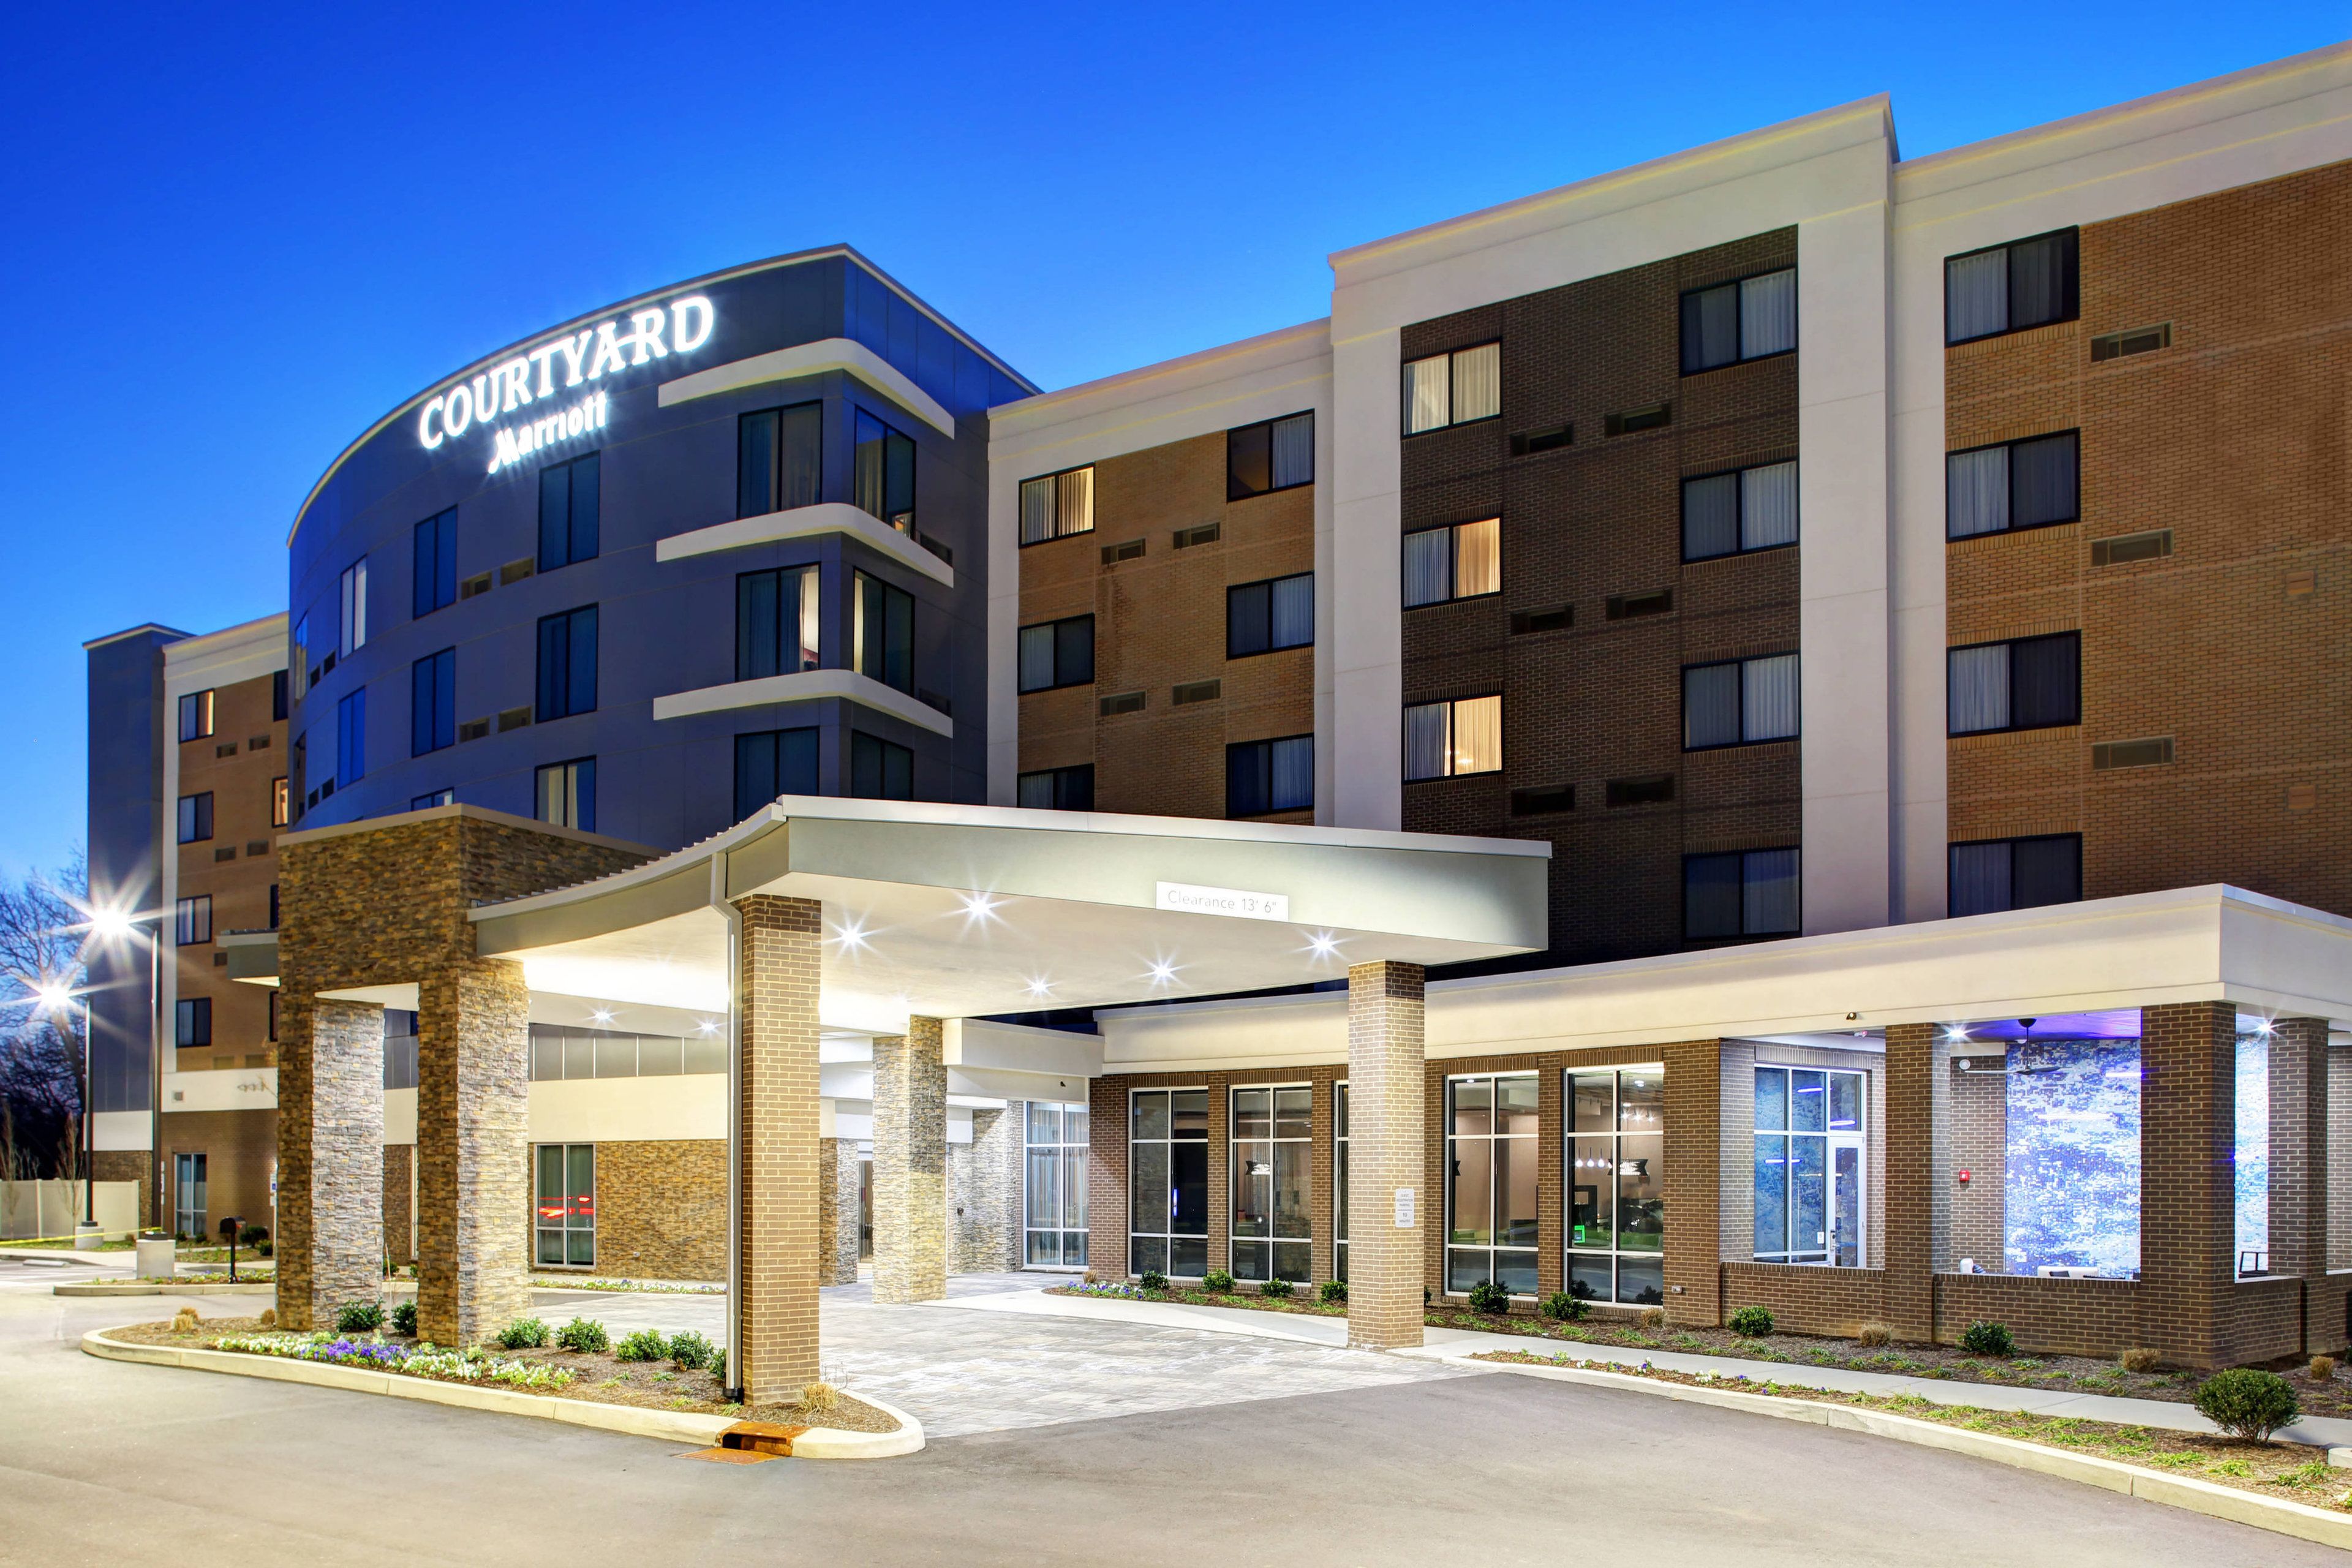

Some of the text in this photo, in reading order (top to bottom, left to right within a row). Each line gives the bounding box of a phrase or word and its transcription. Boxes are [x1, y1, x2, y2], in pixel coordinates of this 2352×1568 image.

[420, 296, 713, 449] COURTYARD
[488, 391, 608, 473] Marriott
[1167, 890, 1235, 910] Clearance
[1242, 898, 1259, 911] 13'
